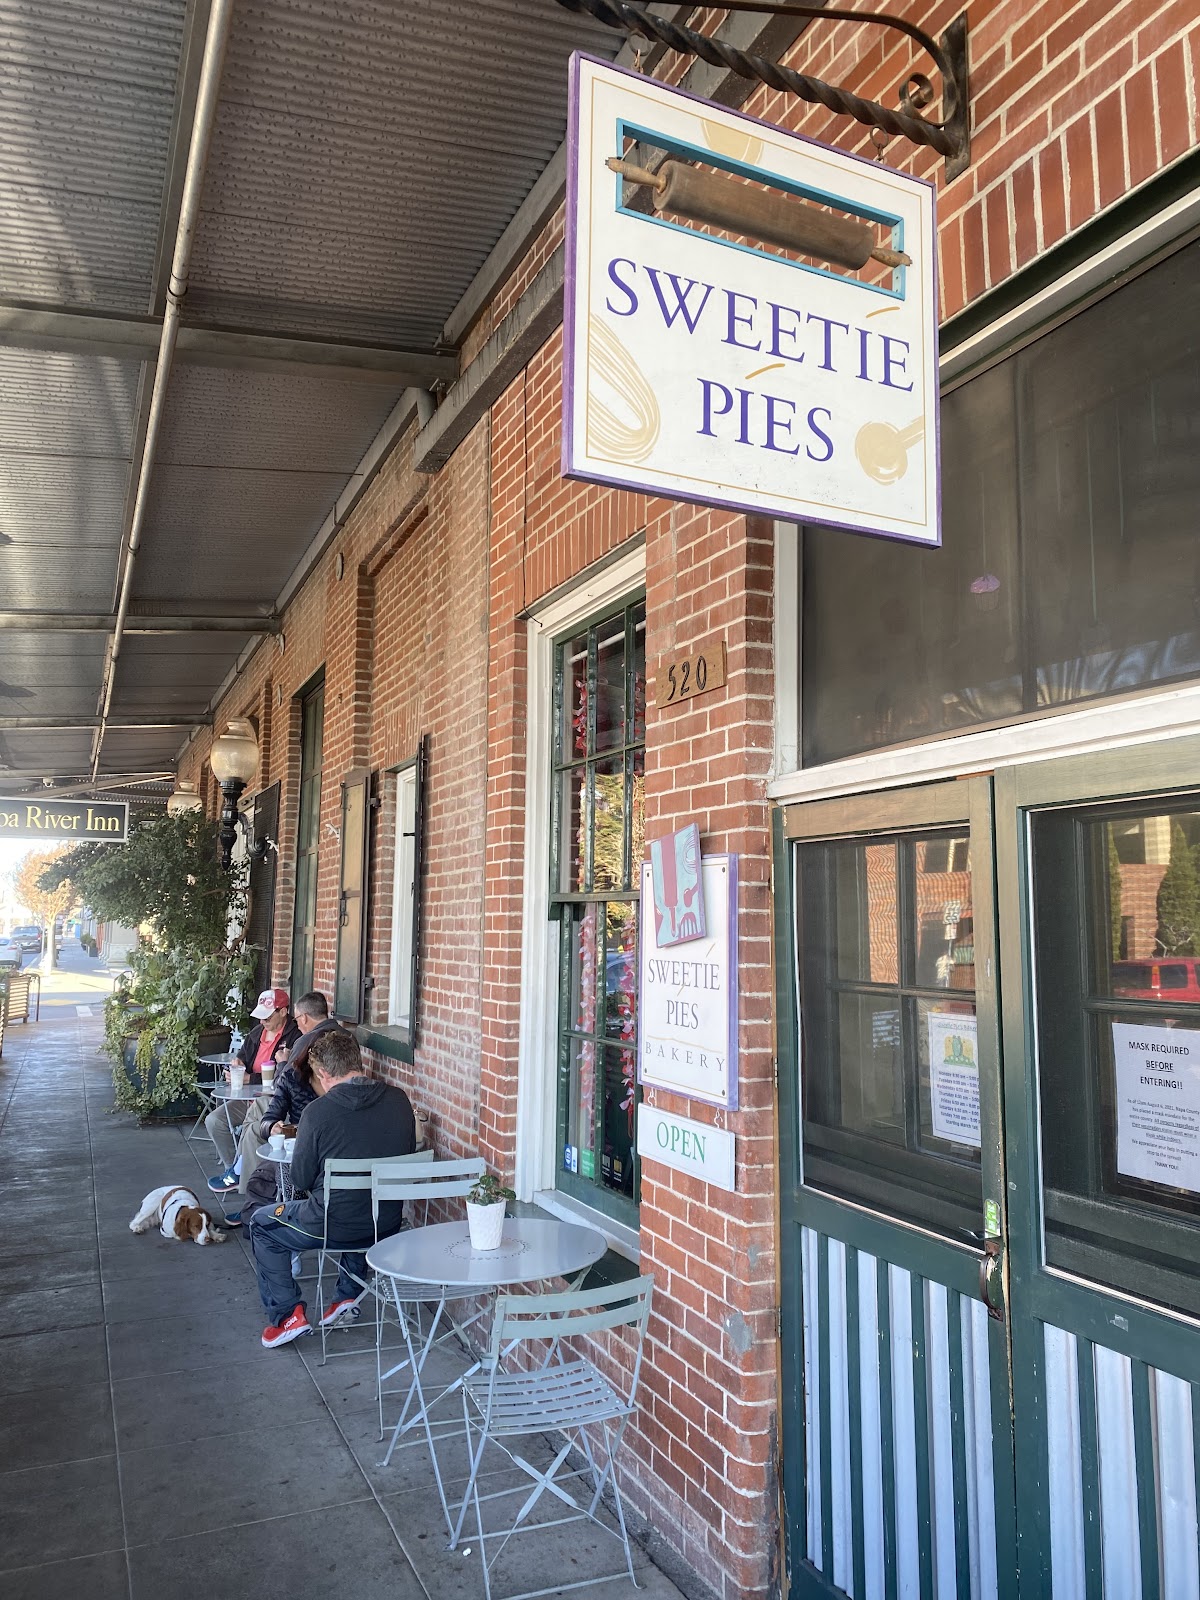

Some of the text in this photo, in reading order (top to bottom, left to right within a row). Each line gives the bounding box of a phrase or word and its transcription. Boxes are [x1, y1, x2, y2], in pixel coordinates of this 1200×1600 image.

[606, 257, 914, 392] SWEETIE
[696, 378, 834, 462] PIES
[667, 655, 707, 701] 520
[25, 805, 81, 830] River
[85, 808, 120, 832] Inn
[648, 958, 721, 991] SWEETIE
[666, 999, 699, 1029] PIES
[645, 1041, 726, 1072] BAKERY
[1128, 1041, 1190, 1056] MASK REQUIRED
[1145, 1060, 1174, 1072] BEFORE
[1140, 1076, 1183, 1090] ENTERING!!
[656, 1121, 707, 1164] OPEN
